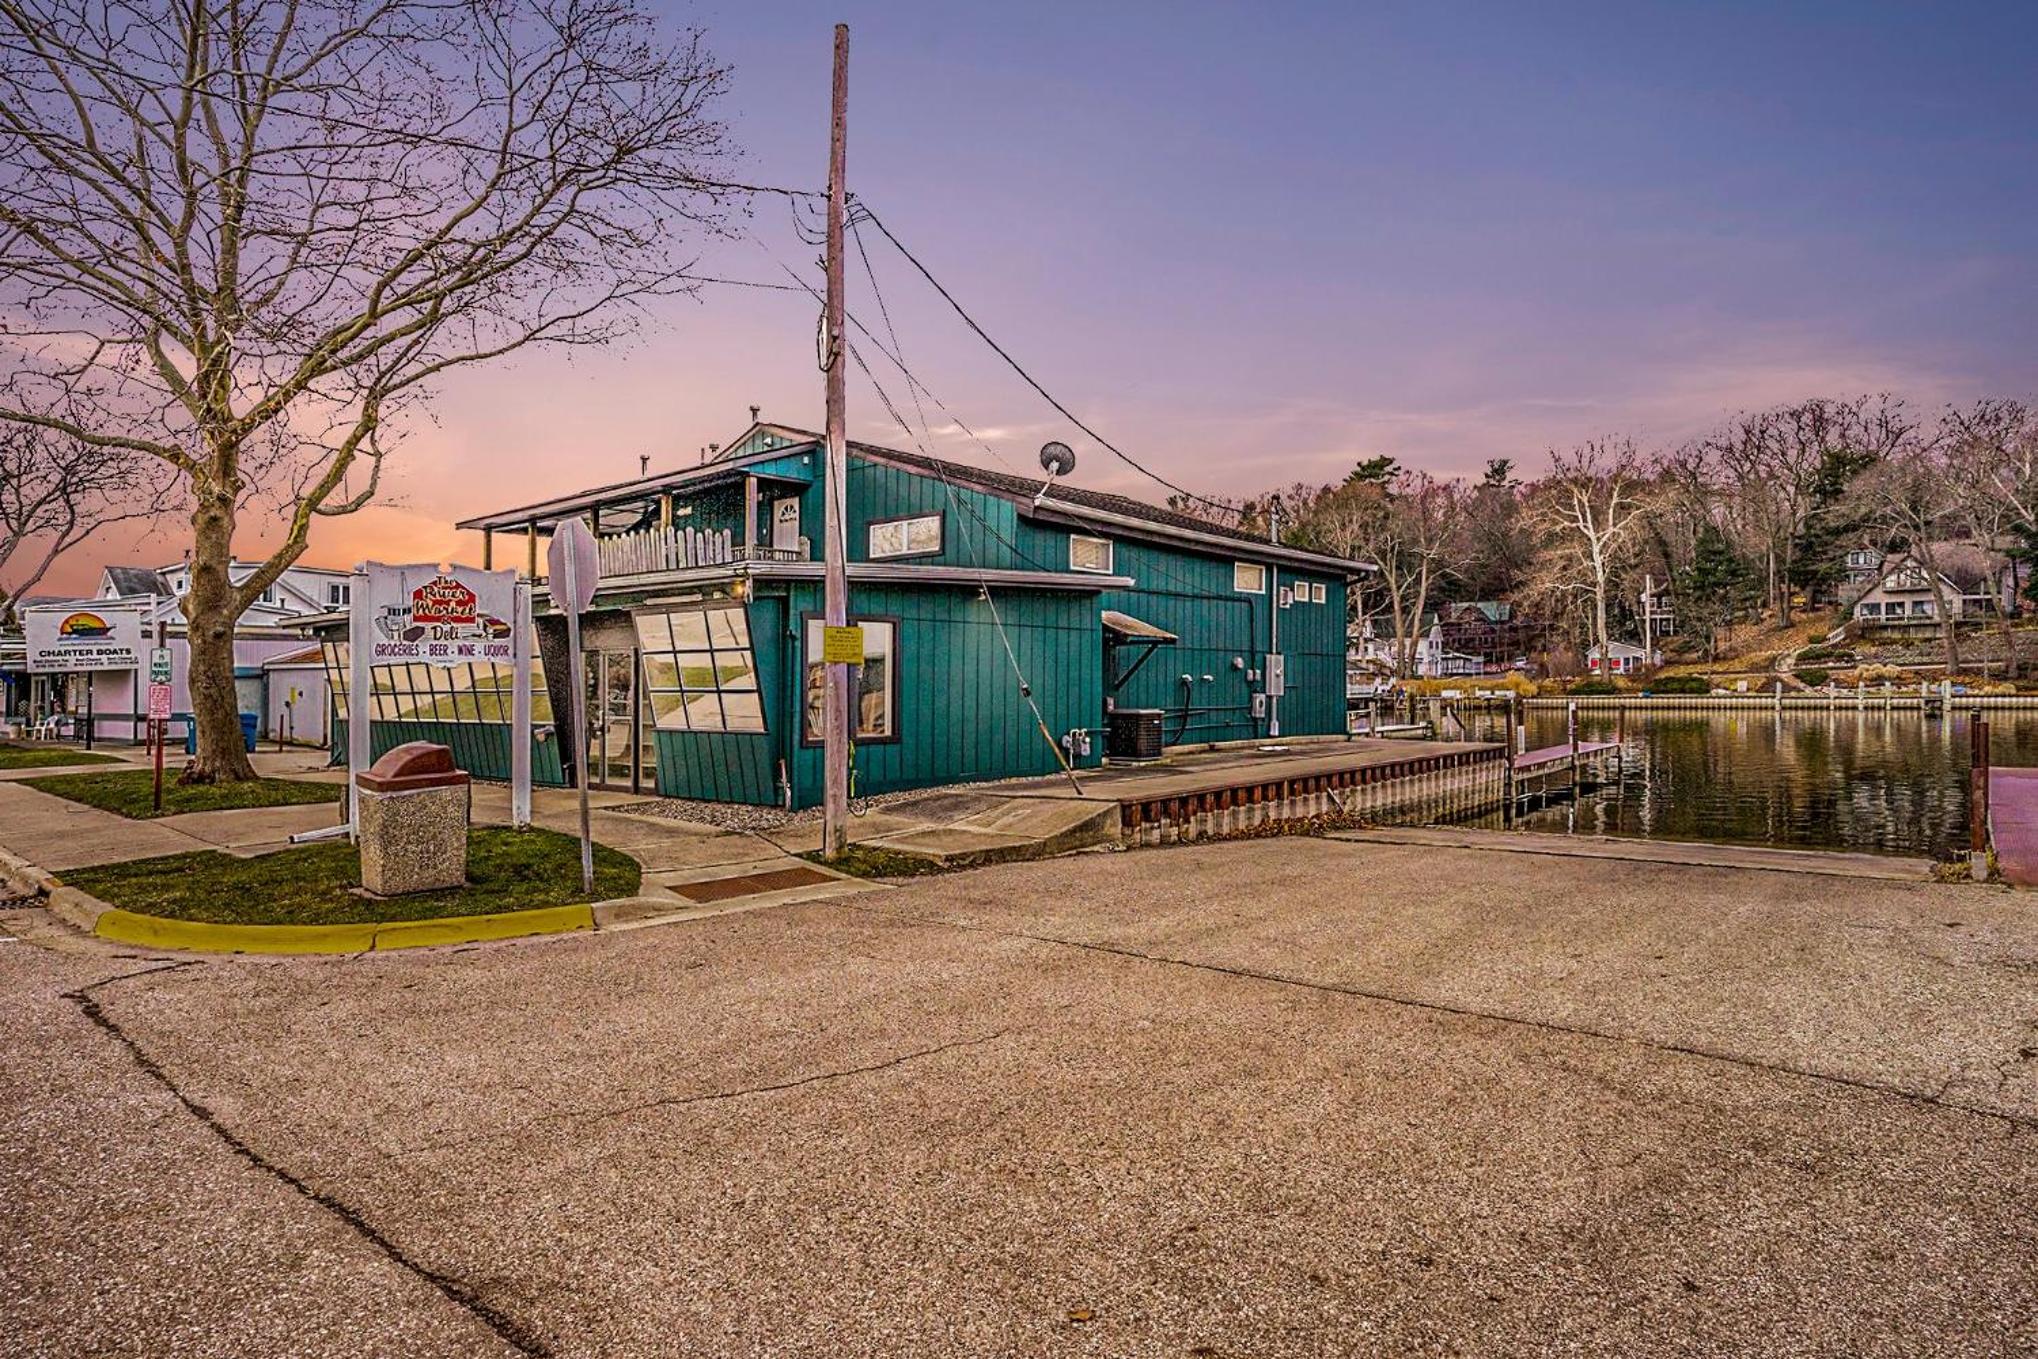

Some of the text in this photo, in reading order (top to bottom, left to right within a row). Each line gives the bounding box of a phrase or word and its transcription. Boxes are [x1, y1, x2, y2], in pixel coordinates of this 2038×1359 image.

[436, 576, 456, 585] The
[422, 585, 466, 599] River
[415, 600, 477, 615] Market
[431, 625, 459, 640] Deli
[39, 648, 132, 657] CHARTER BOATS
[374, 643, 510, 657] GROCERIES BEER WINE LIQUOR
